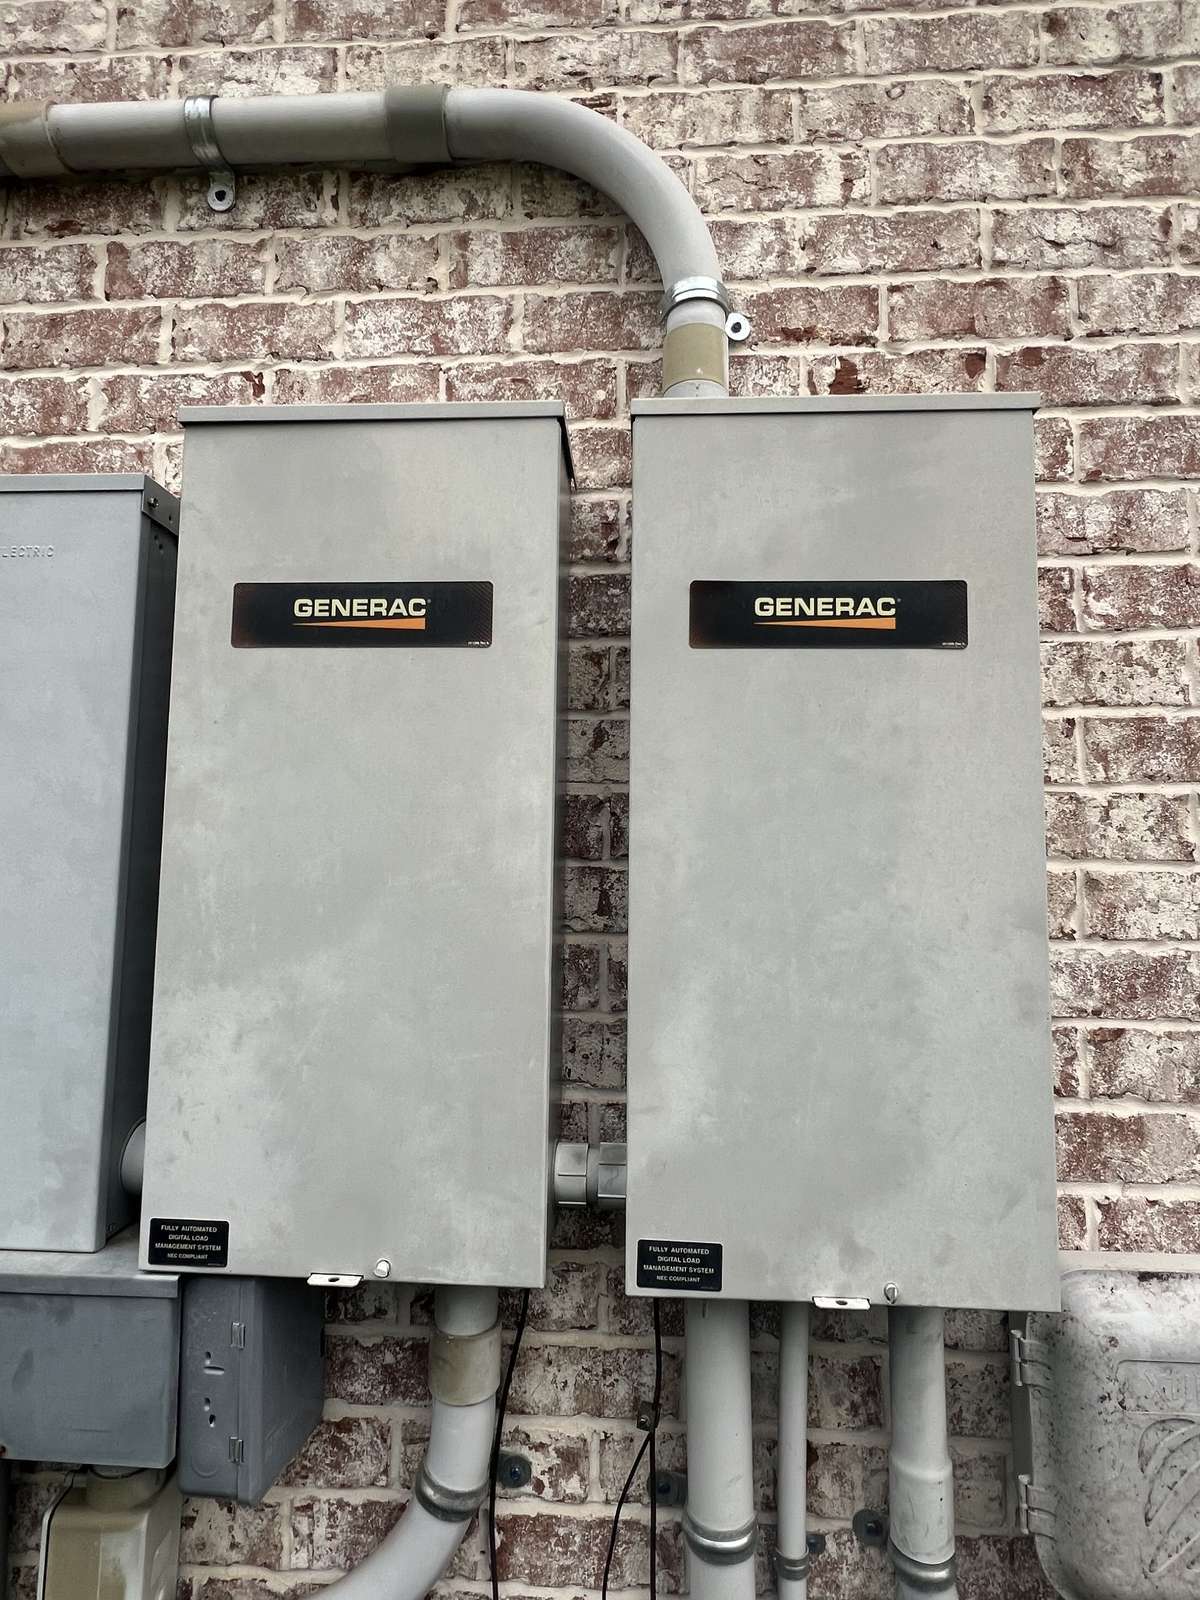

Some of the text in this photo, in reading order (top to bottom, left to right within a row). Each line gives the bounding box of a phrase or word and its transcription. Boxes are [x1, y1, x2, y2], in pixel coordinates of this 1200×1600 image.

[293, 597, 427, 617] GENERAC
[754, 597, 897, 617] GENERAC
[160, 1224, 218, 1233] FULLY AUTOMATED
[670, 1247, 710, 1255] AUTOMATED
[643, 1264, 715, 1274] MANAGEMENT SYSTEM
[668, 1275, 700, 1283] COMPLIANT
